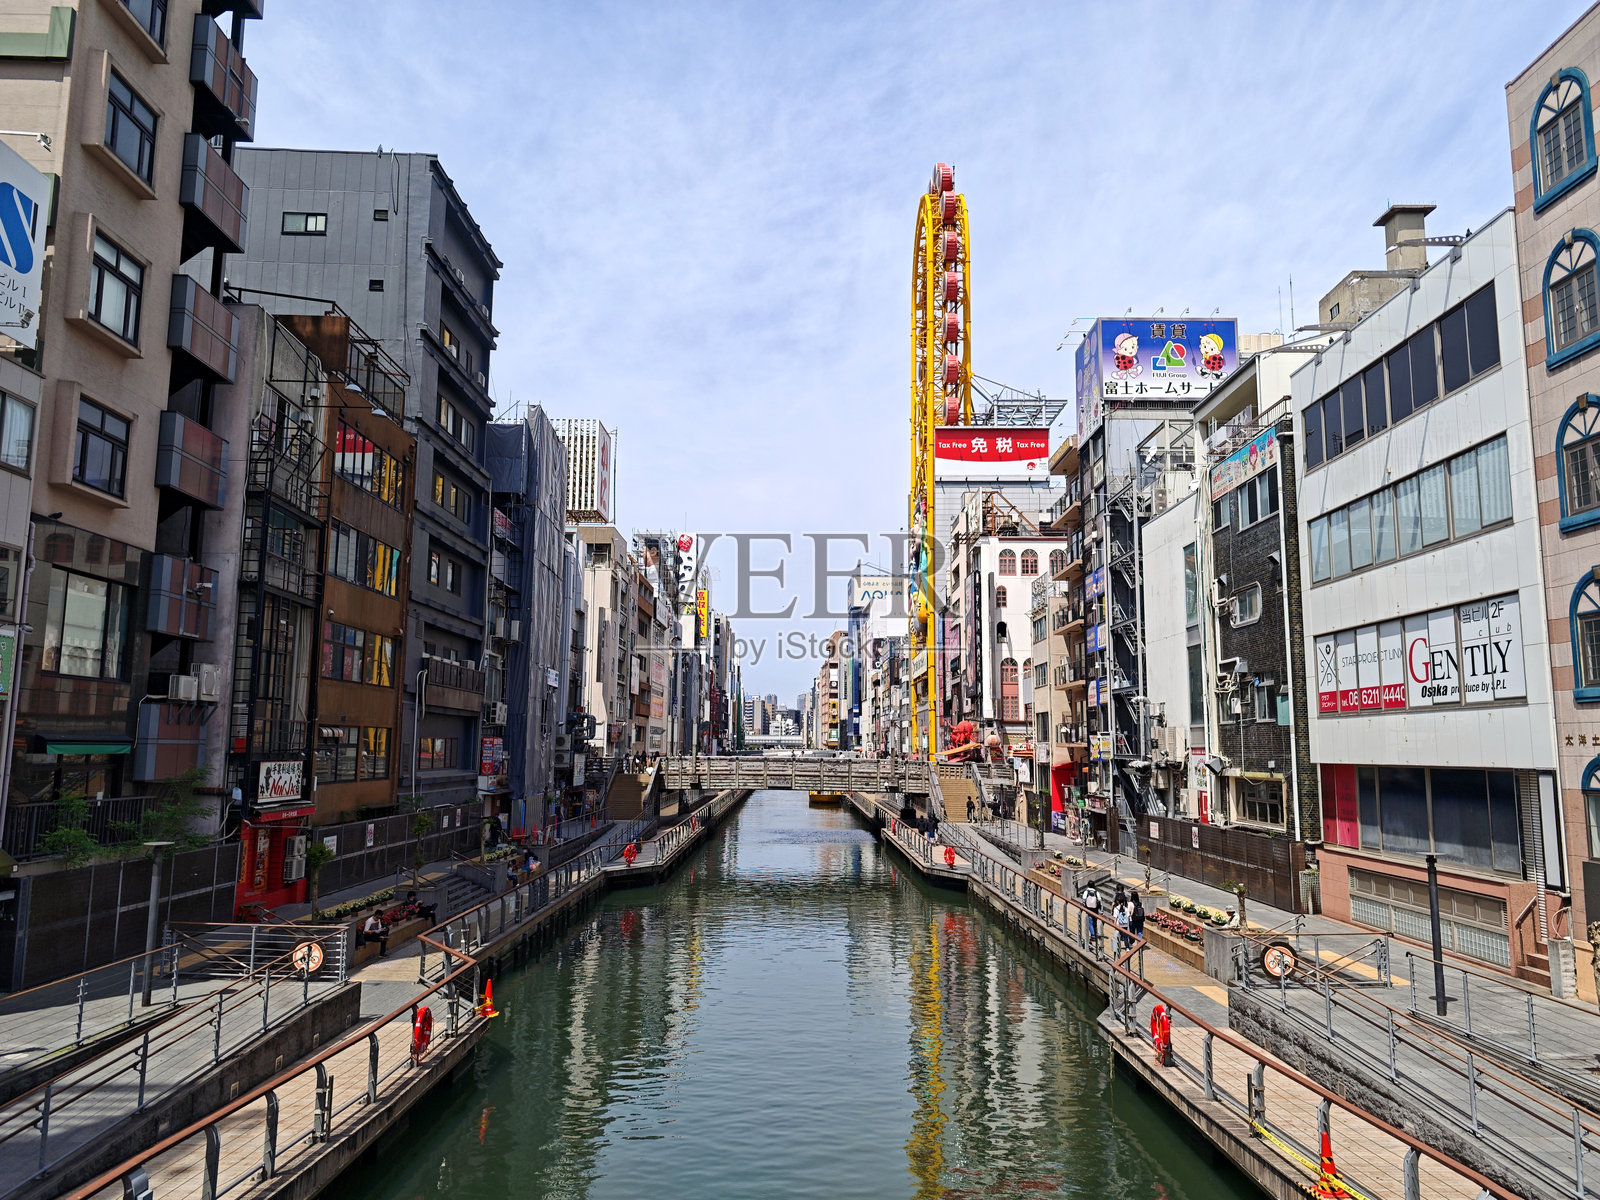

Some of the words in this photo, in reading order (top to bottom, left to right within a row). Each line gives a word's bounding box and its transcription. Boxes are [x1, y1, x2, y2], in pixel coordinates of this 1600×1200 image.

[938, 441, 951, 449] Tax
[952, 441, 967, 449] Free
[1016, 441, 1030, 449] Tax
[1030, 441, 1046, 449] Free
[1490, 600, 1505, 619] 2F
[1478, 622, 1512, 637] cub
[1408, 637, 1513, 684] GENTLY
[1348, 691, 1359, 706] 06
[1361, 688, 1380, 705] 6211
[1383, 685, 1406, 702] 4440
[1421, 684, 1448, 698] Osaka
[1481, 681, 1490, 693] by
